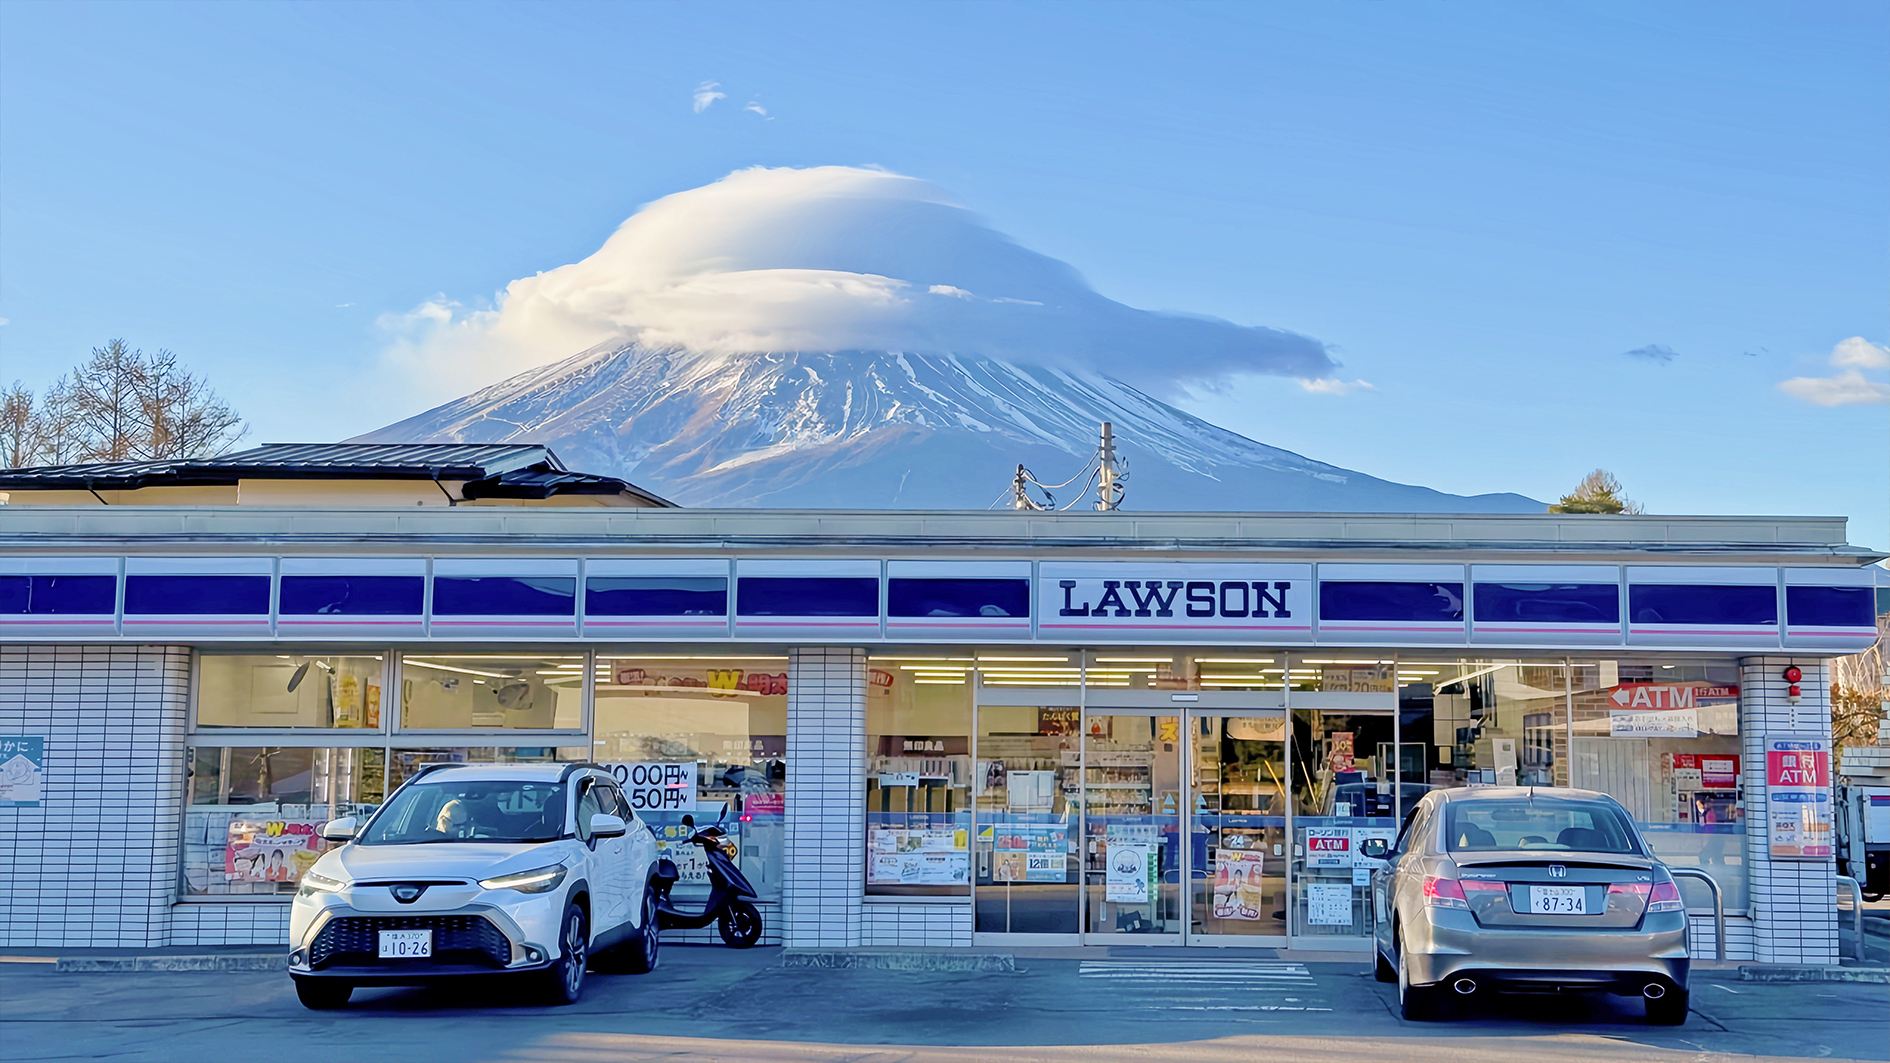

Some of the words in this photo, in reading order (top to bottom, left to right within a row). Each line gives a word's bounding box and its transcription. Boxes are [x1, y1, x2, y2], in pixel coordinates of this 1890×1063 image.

[1059, 580, 1291, 618] LAWSON
[1631, 686, 1693, 708] ATM
[0, 741, 28, 752] かに
[1780, 769, 1817, 783] ATM
[623, 788, 688, 809] 50円~
[1315, 839, 1343, 850] ATM
[1543, 898, 1582, 911] 87-34
[393, 942, 428, 955] 10-26
